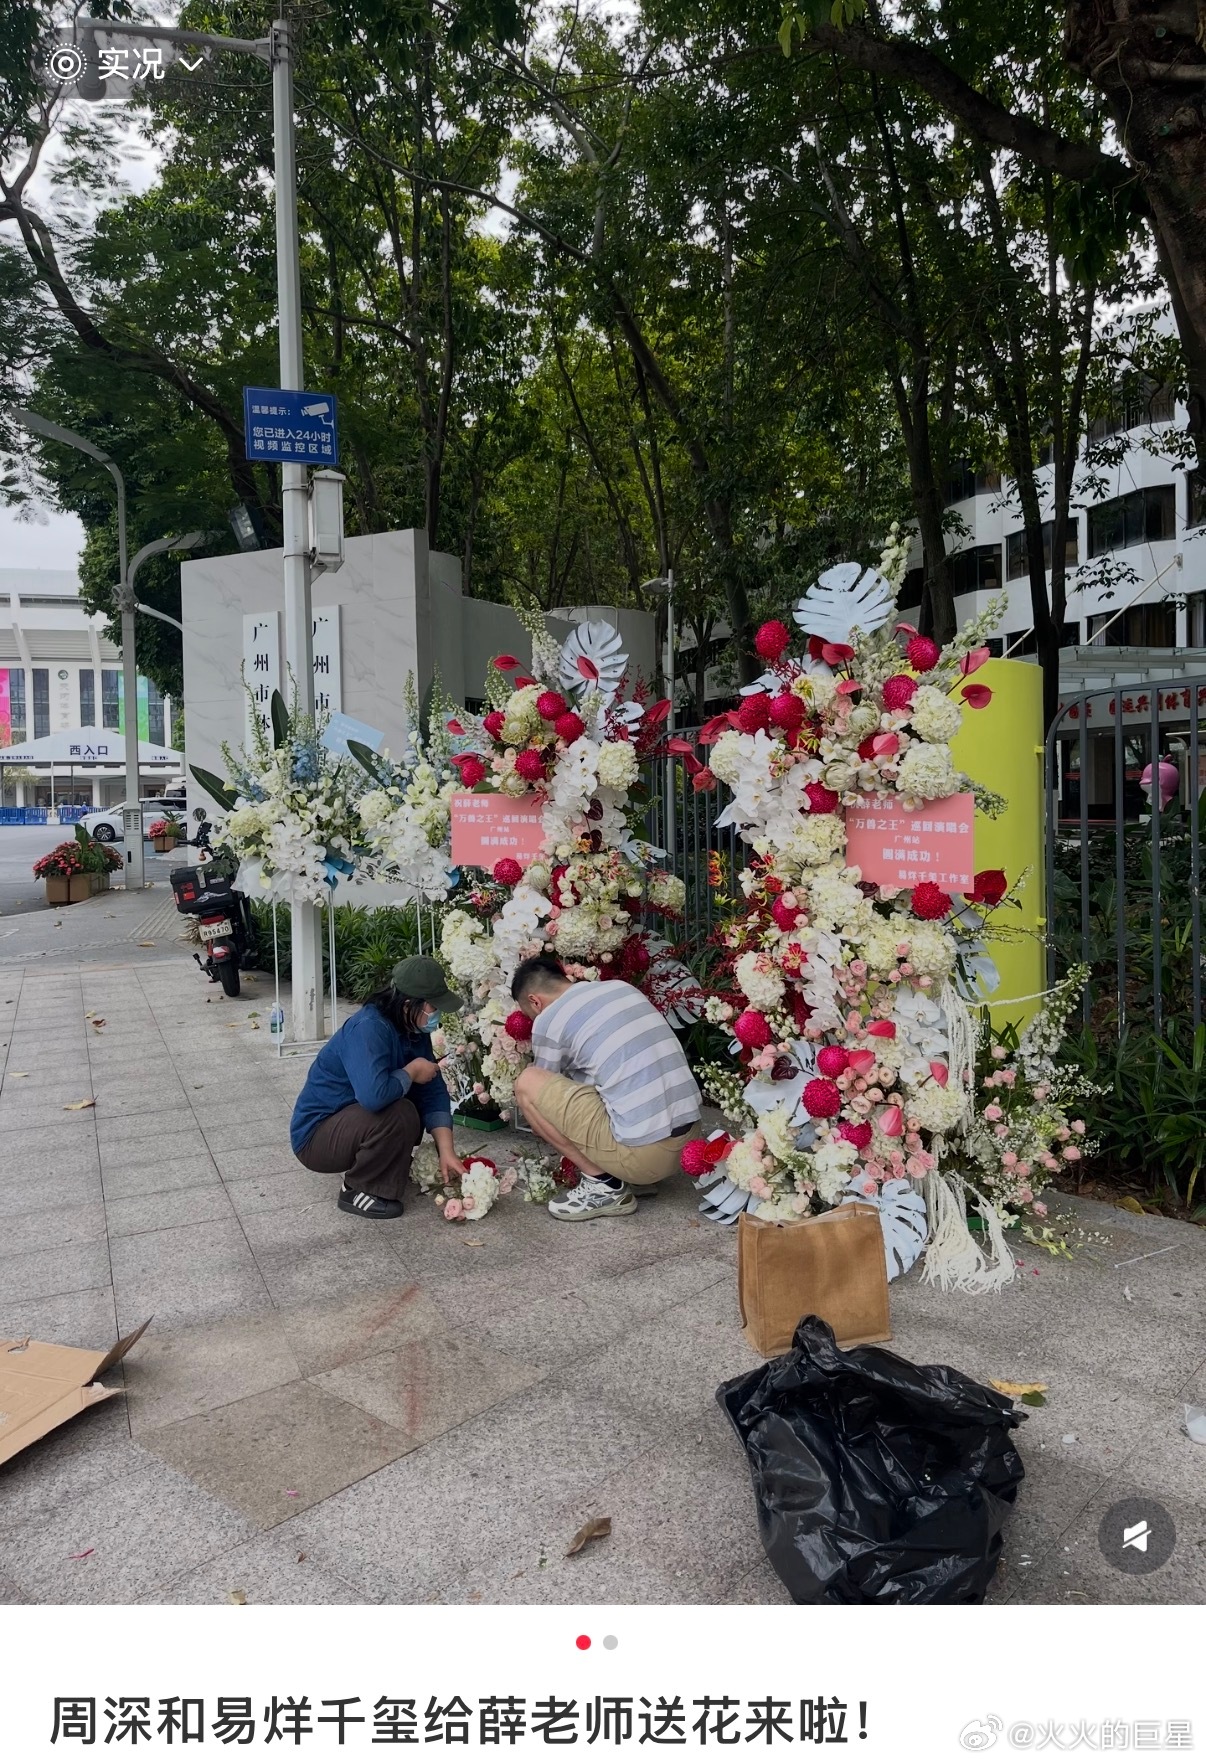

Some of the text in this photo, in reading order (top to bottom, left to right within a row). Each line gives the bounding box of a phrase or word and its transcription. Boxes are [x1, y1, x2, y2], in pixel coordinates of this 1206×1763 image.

[252, 426, 331, 443] 您已进入24小时
[253, 439, 332, 455] 视频监控区域
[69, 744, 109, 756] 西入口
